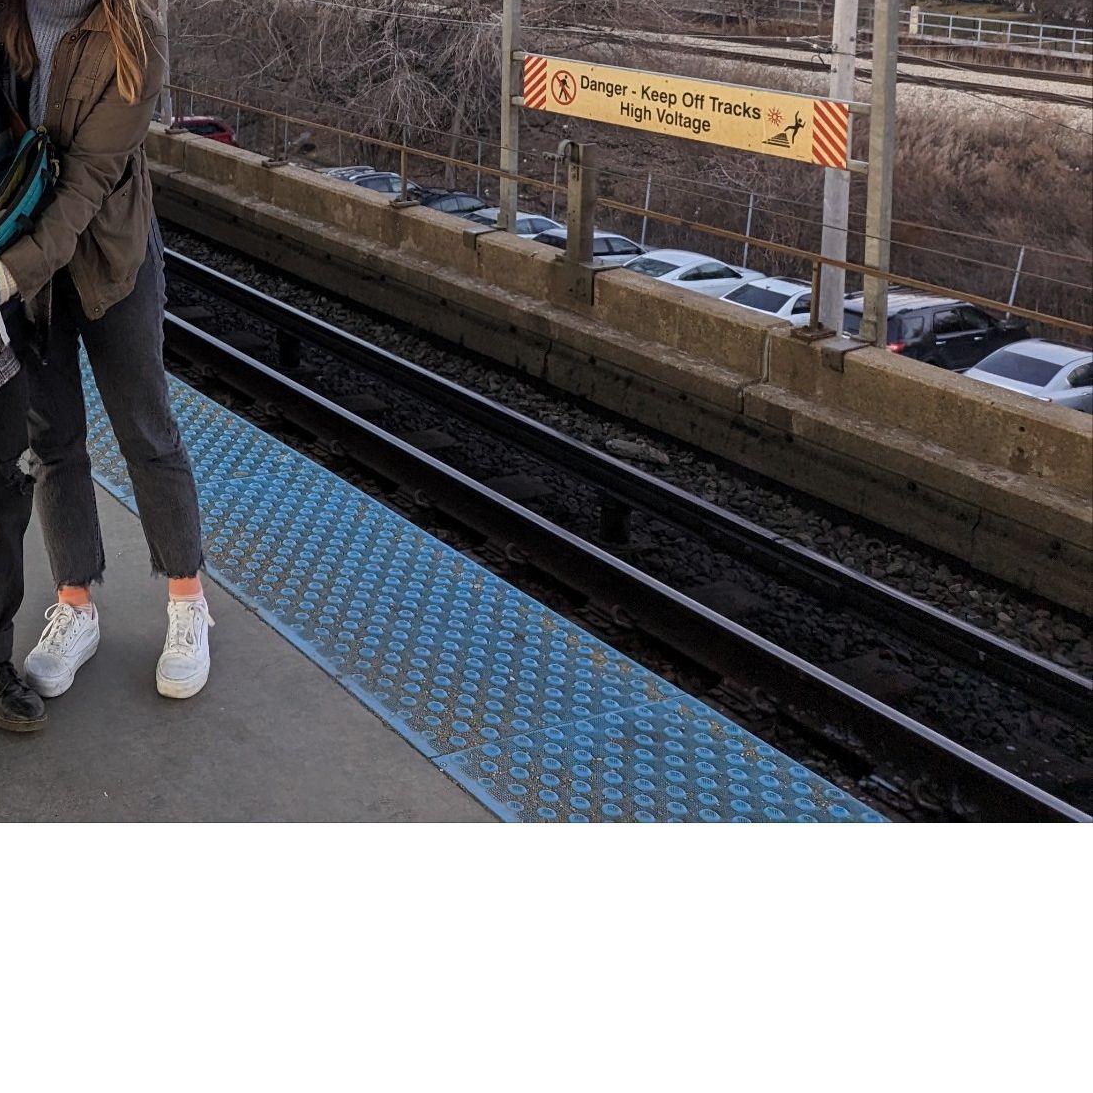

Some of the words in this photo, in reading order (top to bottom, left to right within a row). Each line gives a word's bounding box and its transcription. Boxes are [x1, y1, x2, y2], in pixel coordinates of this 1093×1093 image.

[580, 74, 628, 99] Danger
[641, 85, 677, 107] Keep
[682, 92, 705, 110] Off
[709, 97, 761, 120] Tracks
[620, 101, 652, 124] High
[657, 109, 711, 133] Voltage
